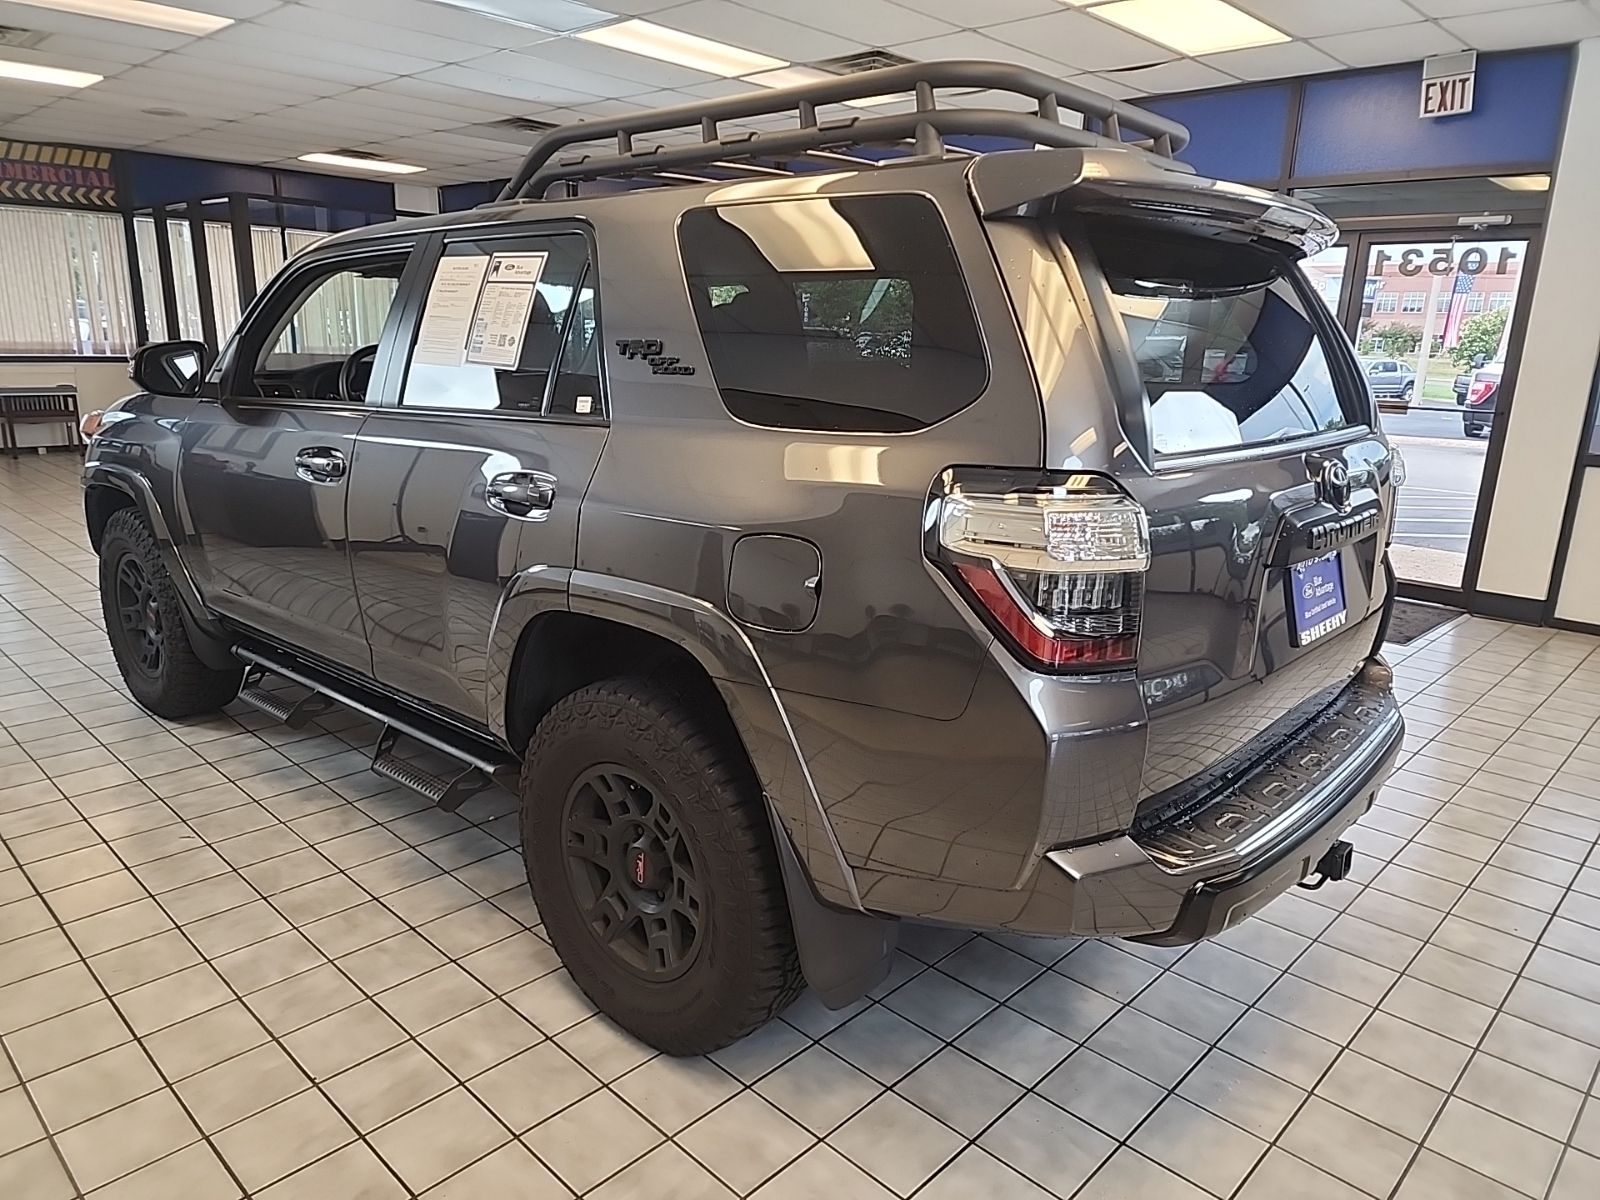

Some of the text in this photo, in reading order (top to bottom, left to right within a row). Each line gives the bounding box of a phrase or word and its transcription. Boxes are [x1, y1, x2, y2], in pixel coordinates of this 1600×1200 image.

[1424, 77, 1470, 114] EXIT
[0, 161, 115, 188] MERCIAL
[616, 339, 663, 360] TRD
[1301, 609, 1347, 646] SHEEHY
